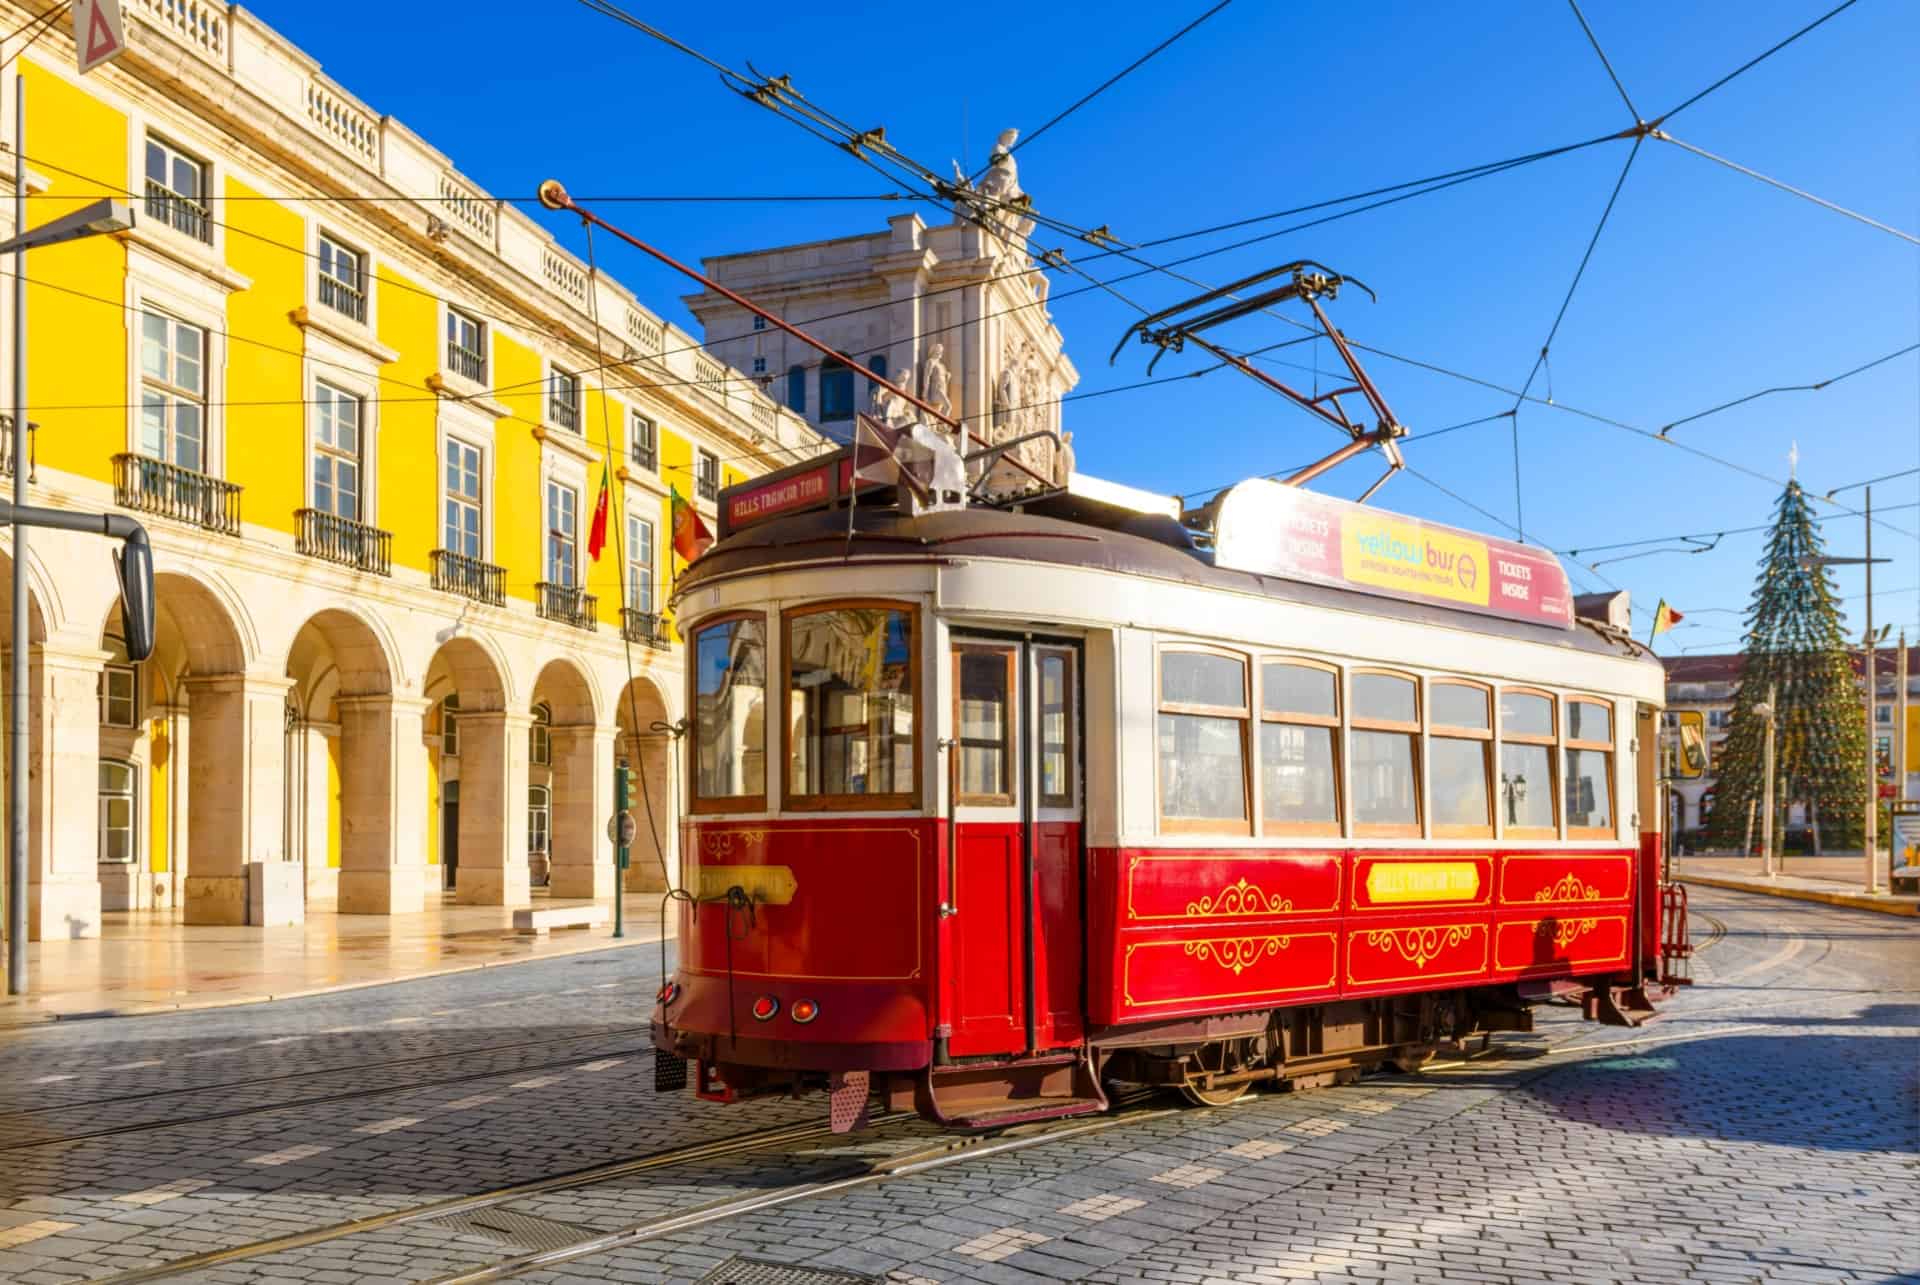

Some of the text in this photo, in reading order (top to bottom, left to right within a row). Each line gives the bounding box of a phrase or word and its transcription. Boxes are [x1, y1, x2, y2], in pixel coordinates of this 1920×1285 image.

[1286, 515, 1329, 537] ICKETS
[1498, 560, 1532, 581] TICKETS
[1501, 582, 1529, 601] INSIDE
